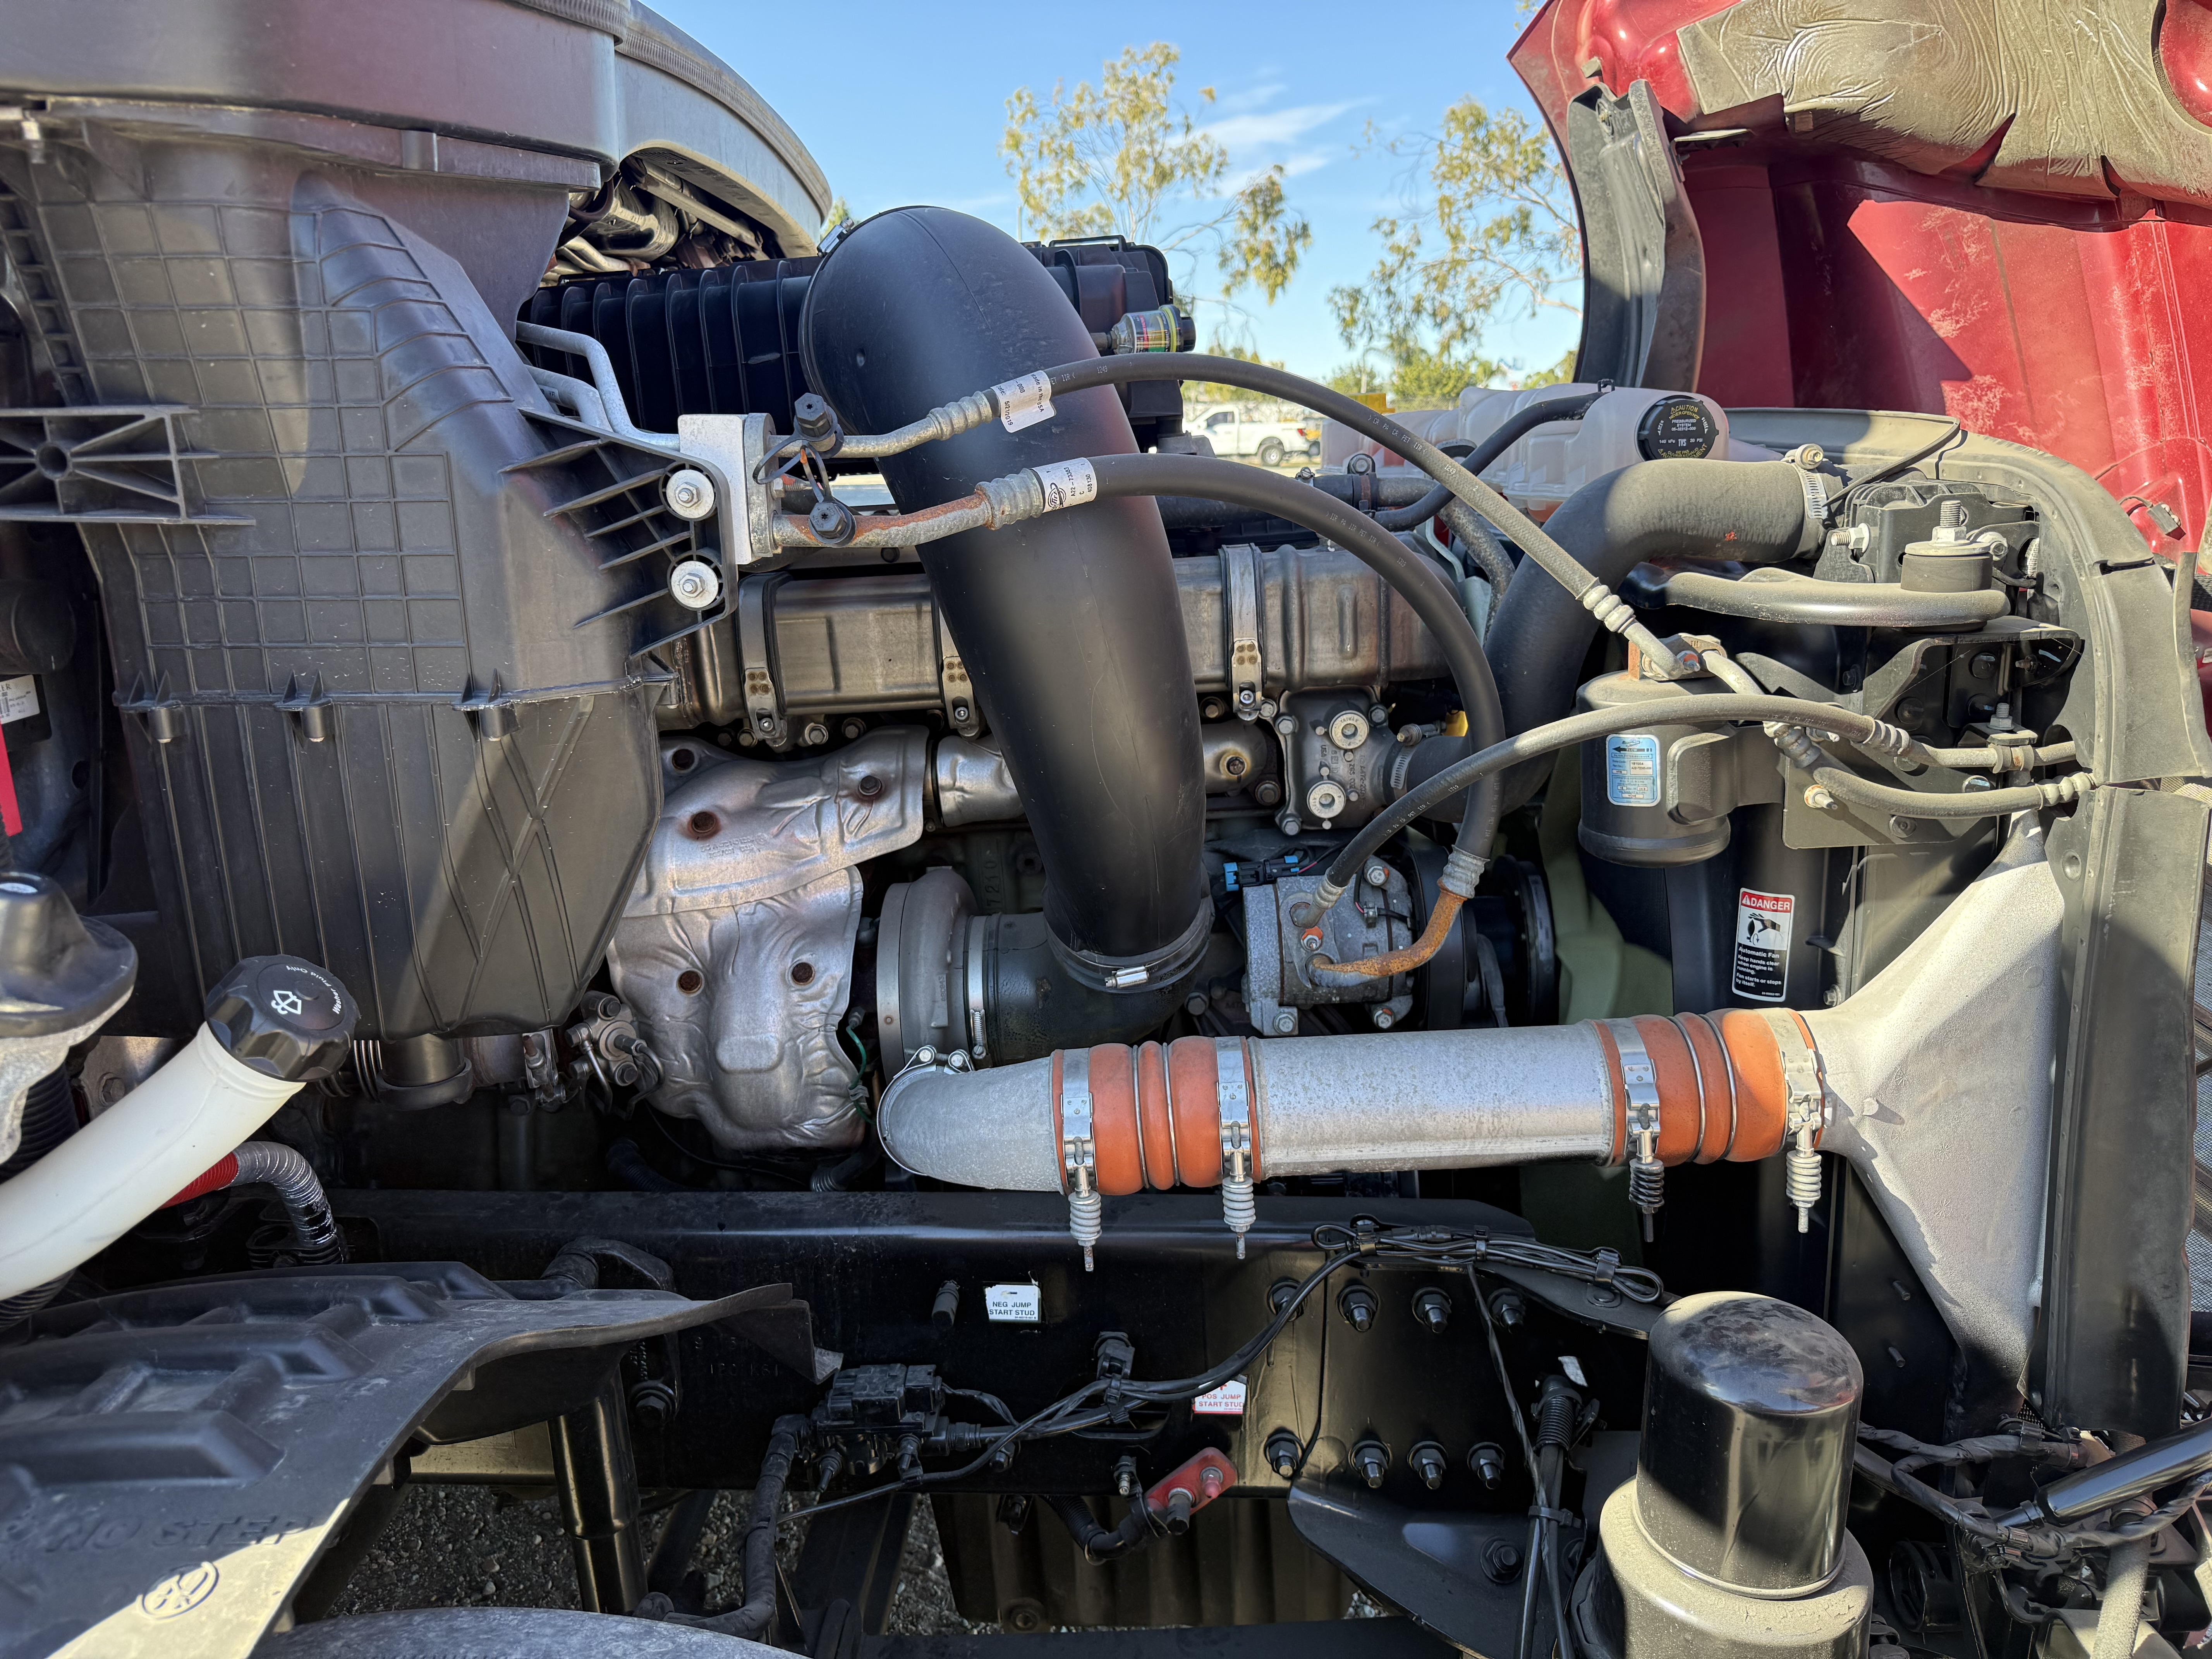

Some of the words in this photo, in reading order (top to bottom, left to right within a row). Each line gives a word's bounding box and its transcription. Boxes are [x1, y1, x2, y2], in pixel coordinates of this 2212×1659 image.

[1669, 411, 1681, 420] NEVER
[1401, 434, 1411, 443] PET
[1444, 464, 1456, 474] 1249
[1750, 898, 1790, 910] DANGER
[1739, 946, 1767, 957] Automatic
[286, 965, 308, 973] Only
[1737, 966, 1755, 975] running.
[311, 972, 332, 987] Fluid
[331, 988, 342, 1014] Washer
[154, 1515, 313, 1546] STEP
